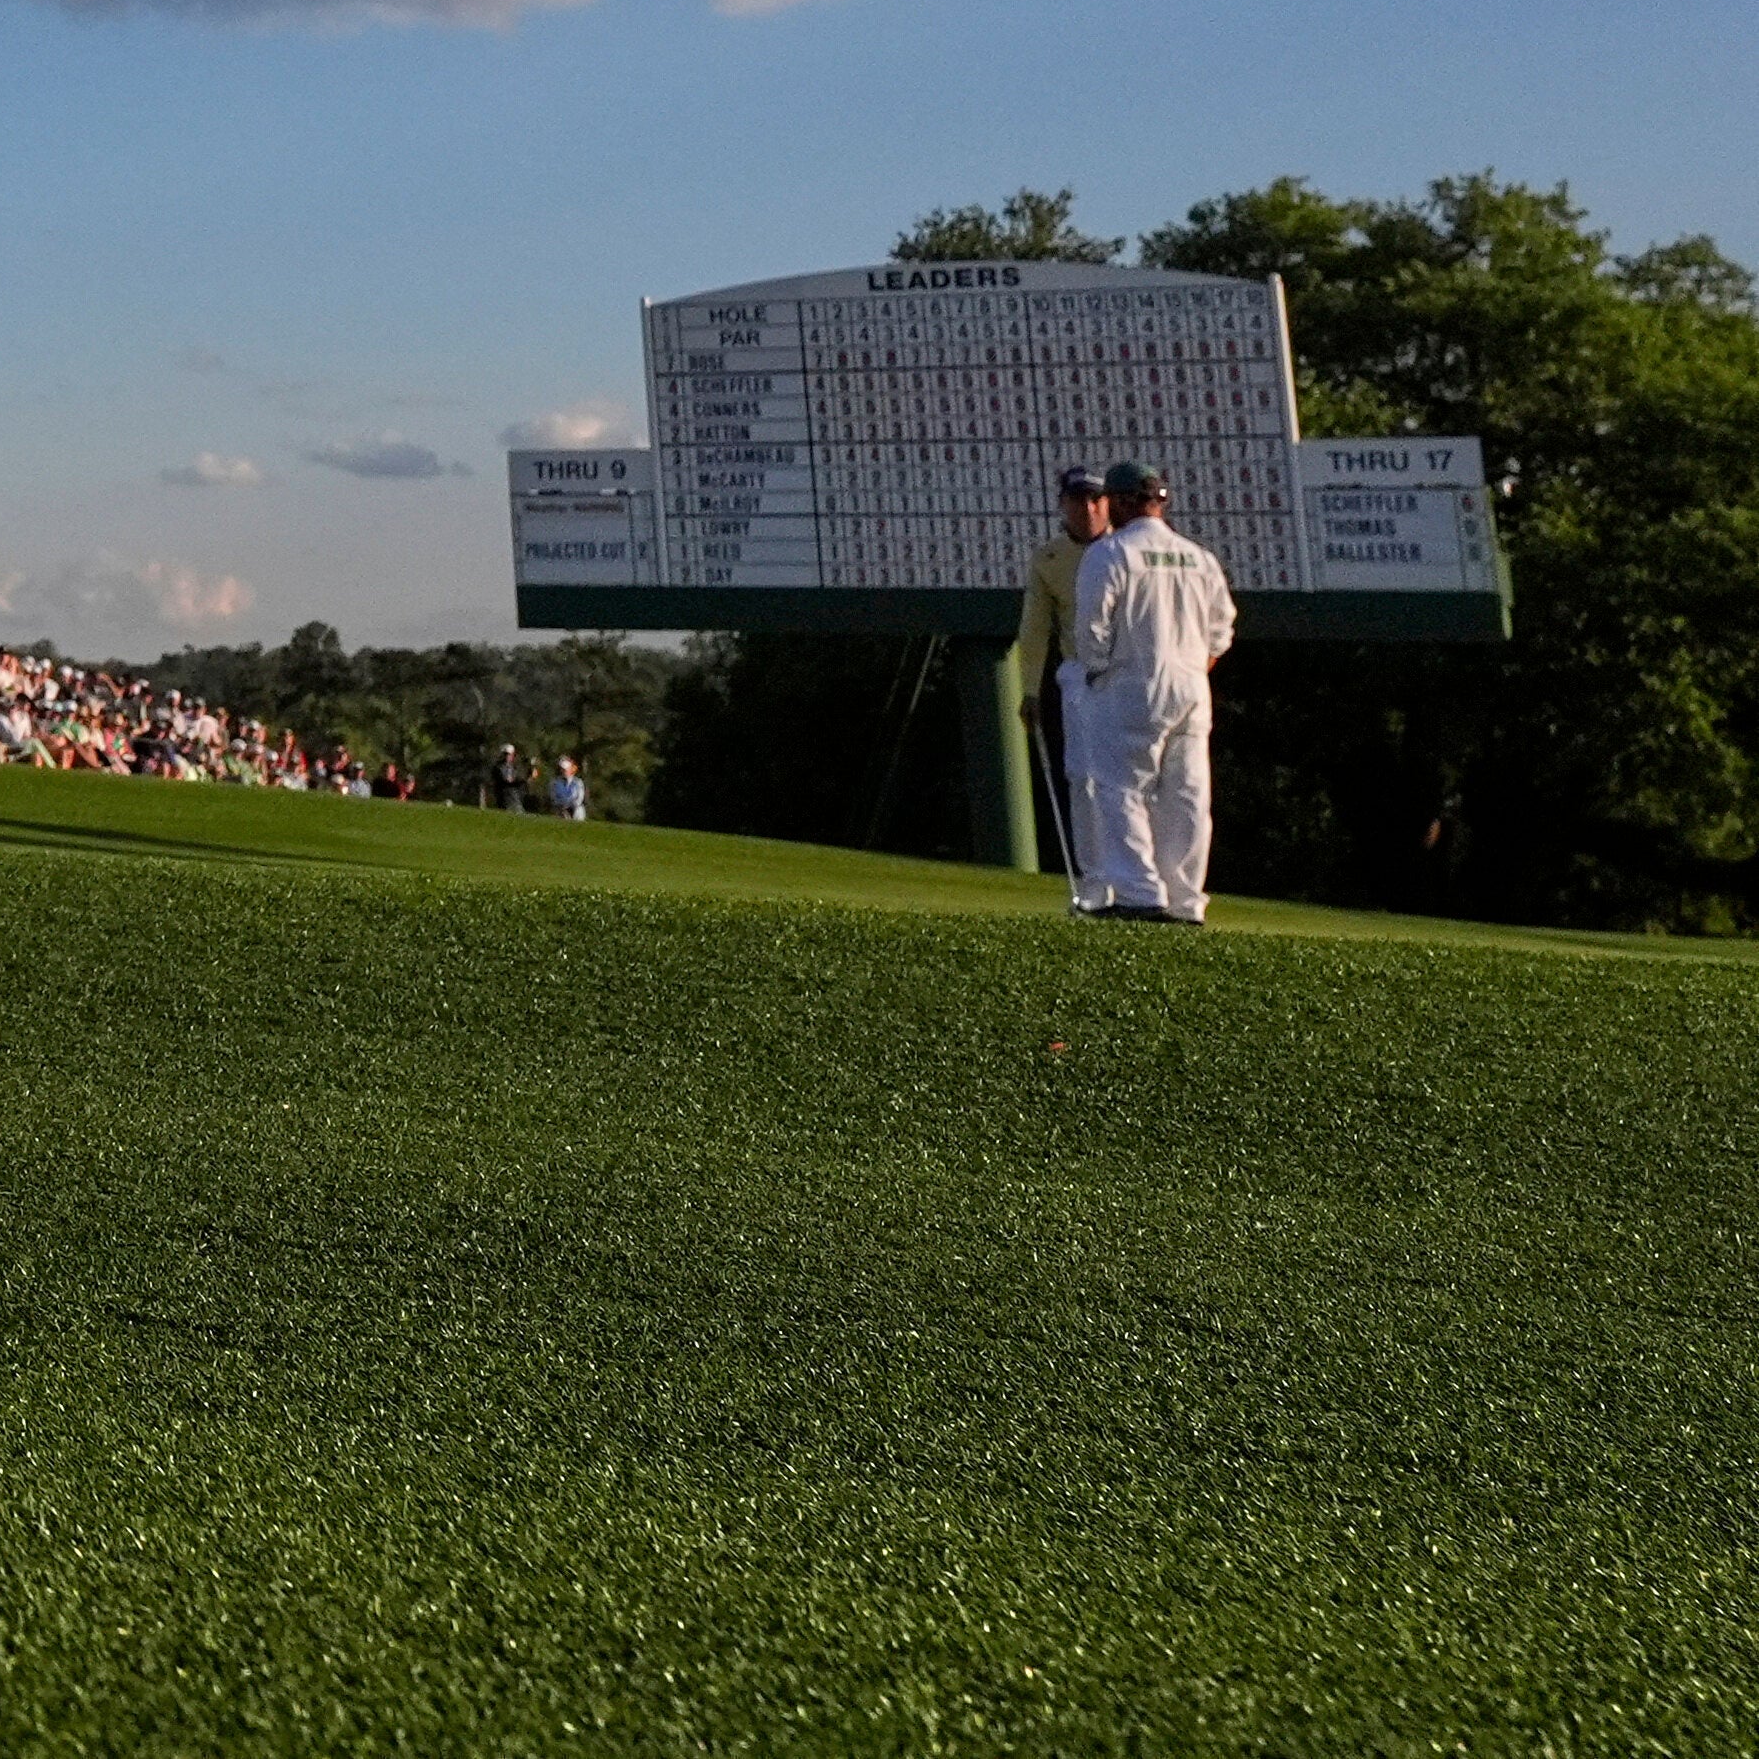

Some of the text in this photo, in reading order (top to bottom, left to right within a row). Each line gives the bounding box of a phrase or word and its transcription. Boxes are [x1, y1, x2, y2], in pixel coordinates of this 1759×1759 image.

[867, 267, 1021, 291] LEADERS
[709, 304, 767, 323] HOLE
[833, 304, 843, 320] 2
[858, 302, 868, 318] 3
[881, 301, 891, 317] 4
[905, 300, 916, 316] 5
[929, 299, 940, 315] 6
[955, 297, 965, 313] 7
[979, 297, 990, 313] 8
[1008, 297, 1018, 313] 9
[1031, 296, 1049, 312] 10
[1058, 294, 1076, 310] 11
[1085, 294, 1103, 310] 12
[1112, 294, 1129, 310] 13
[1139, 293, 1157, 309] 14
[1164, 291, 1181, 307] 15
[1216, 287, 1234, 303] 17
[720, 329, 760, 346] PAR
[691, 376, 772, 392] SCHEFFLER
[534, 459, 626, 480] THRU 9
[1326, 449, 1454, 472] THRU 17
[701, 520, 750, 536] LOWRY
